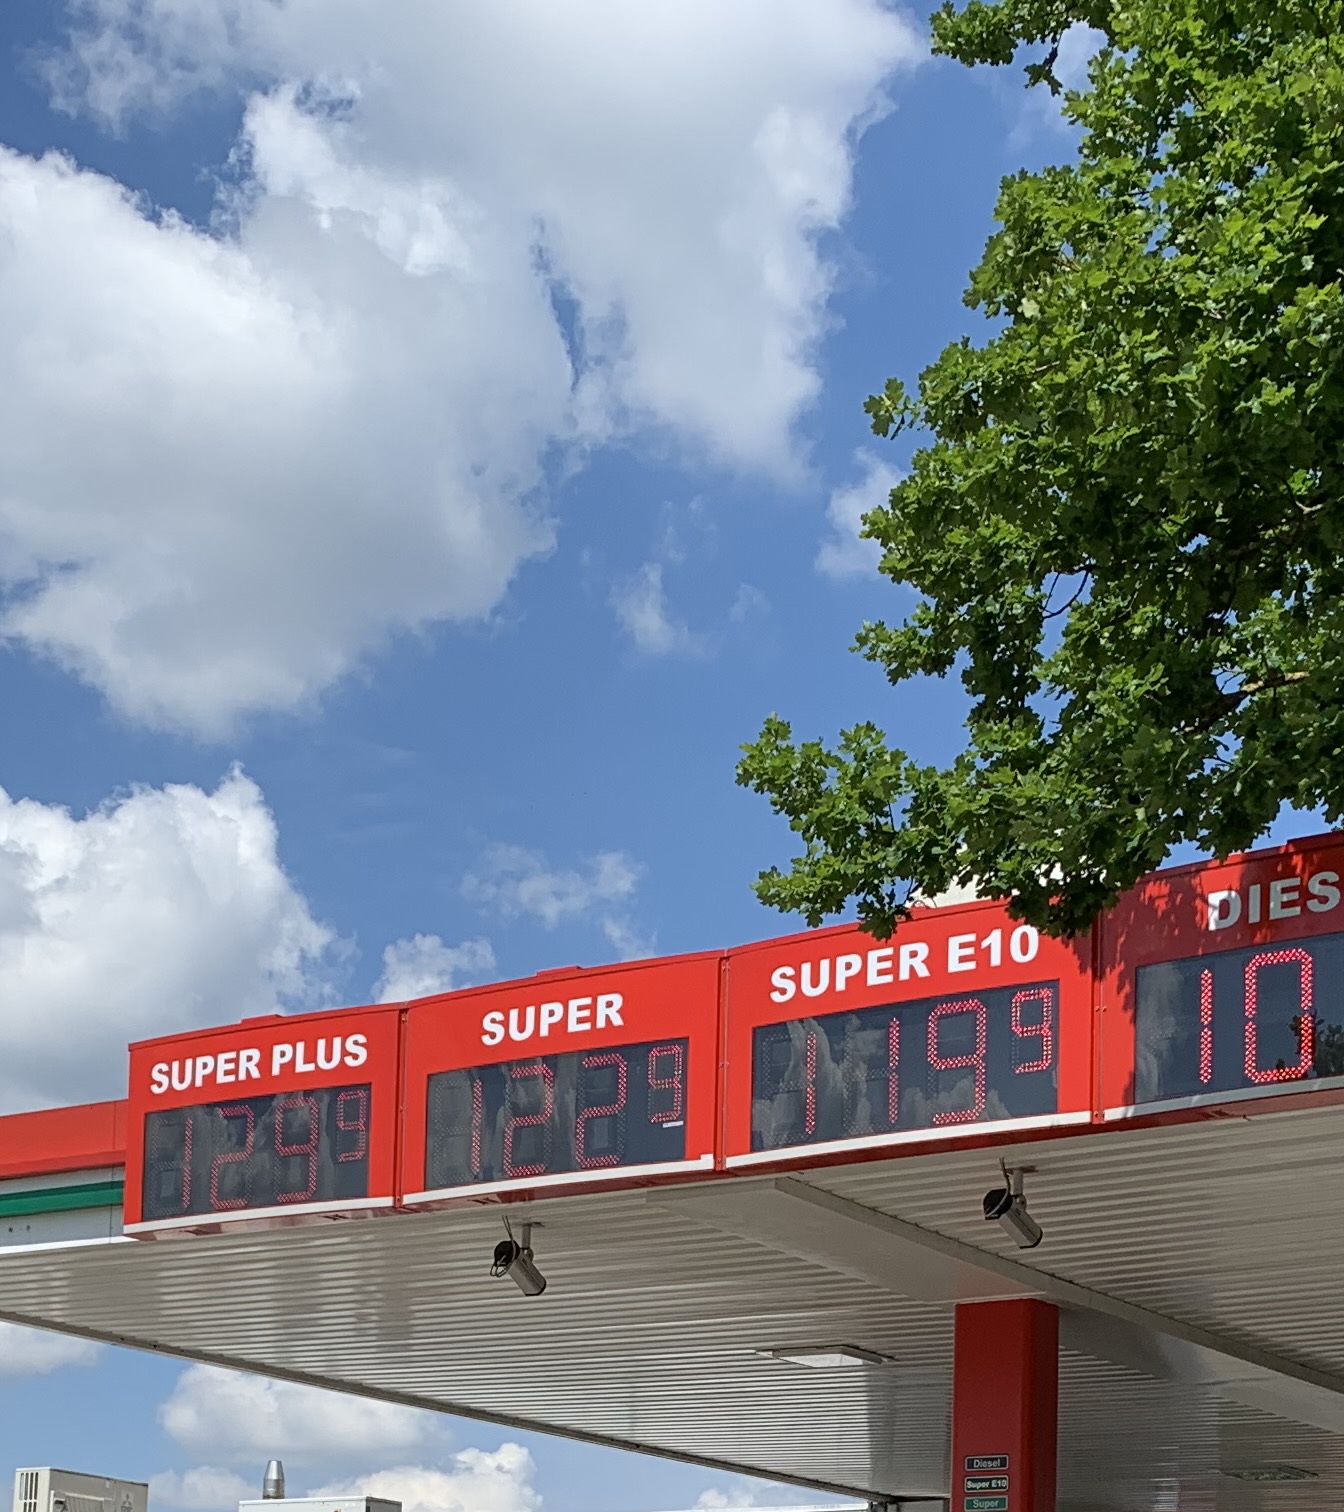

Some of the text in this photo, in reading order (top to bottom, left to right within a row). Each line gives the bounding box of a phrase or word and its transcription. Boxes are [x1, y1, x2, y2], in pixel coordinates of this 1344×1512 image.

[769, 924, 1040, 1003] SUPER E10
[480, 993, 624, 1046] SUPER
[150, 1033, 368, 1094] SUPER PLUS
[973, 1458, 1001, 1468] Diesel
[966, 1480, 1007, 1489] Super E10
[972, 1499, 999, 1509] Super
